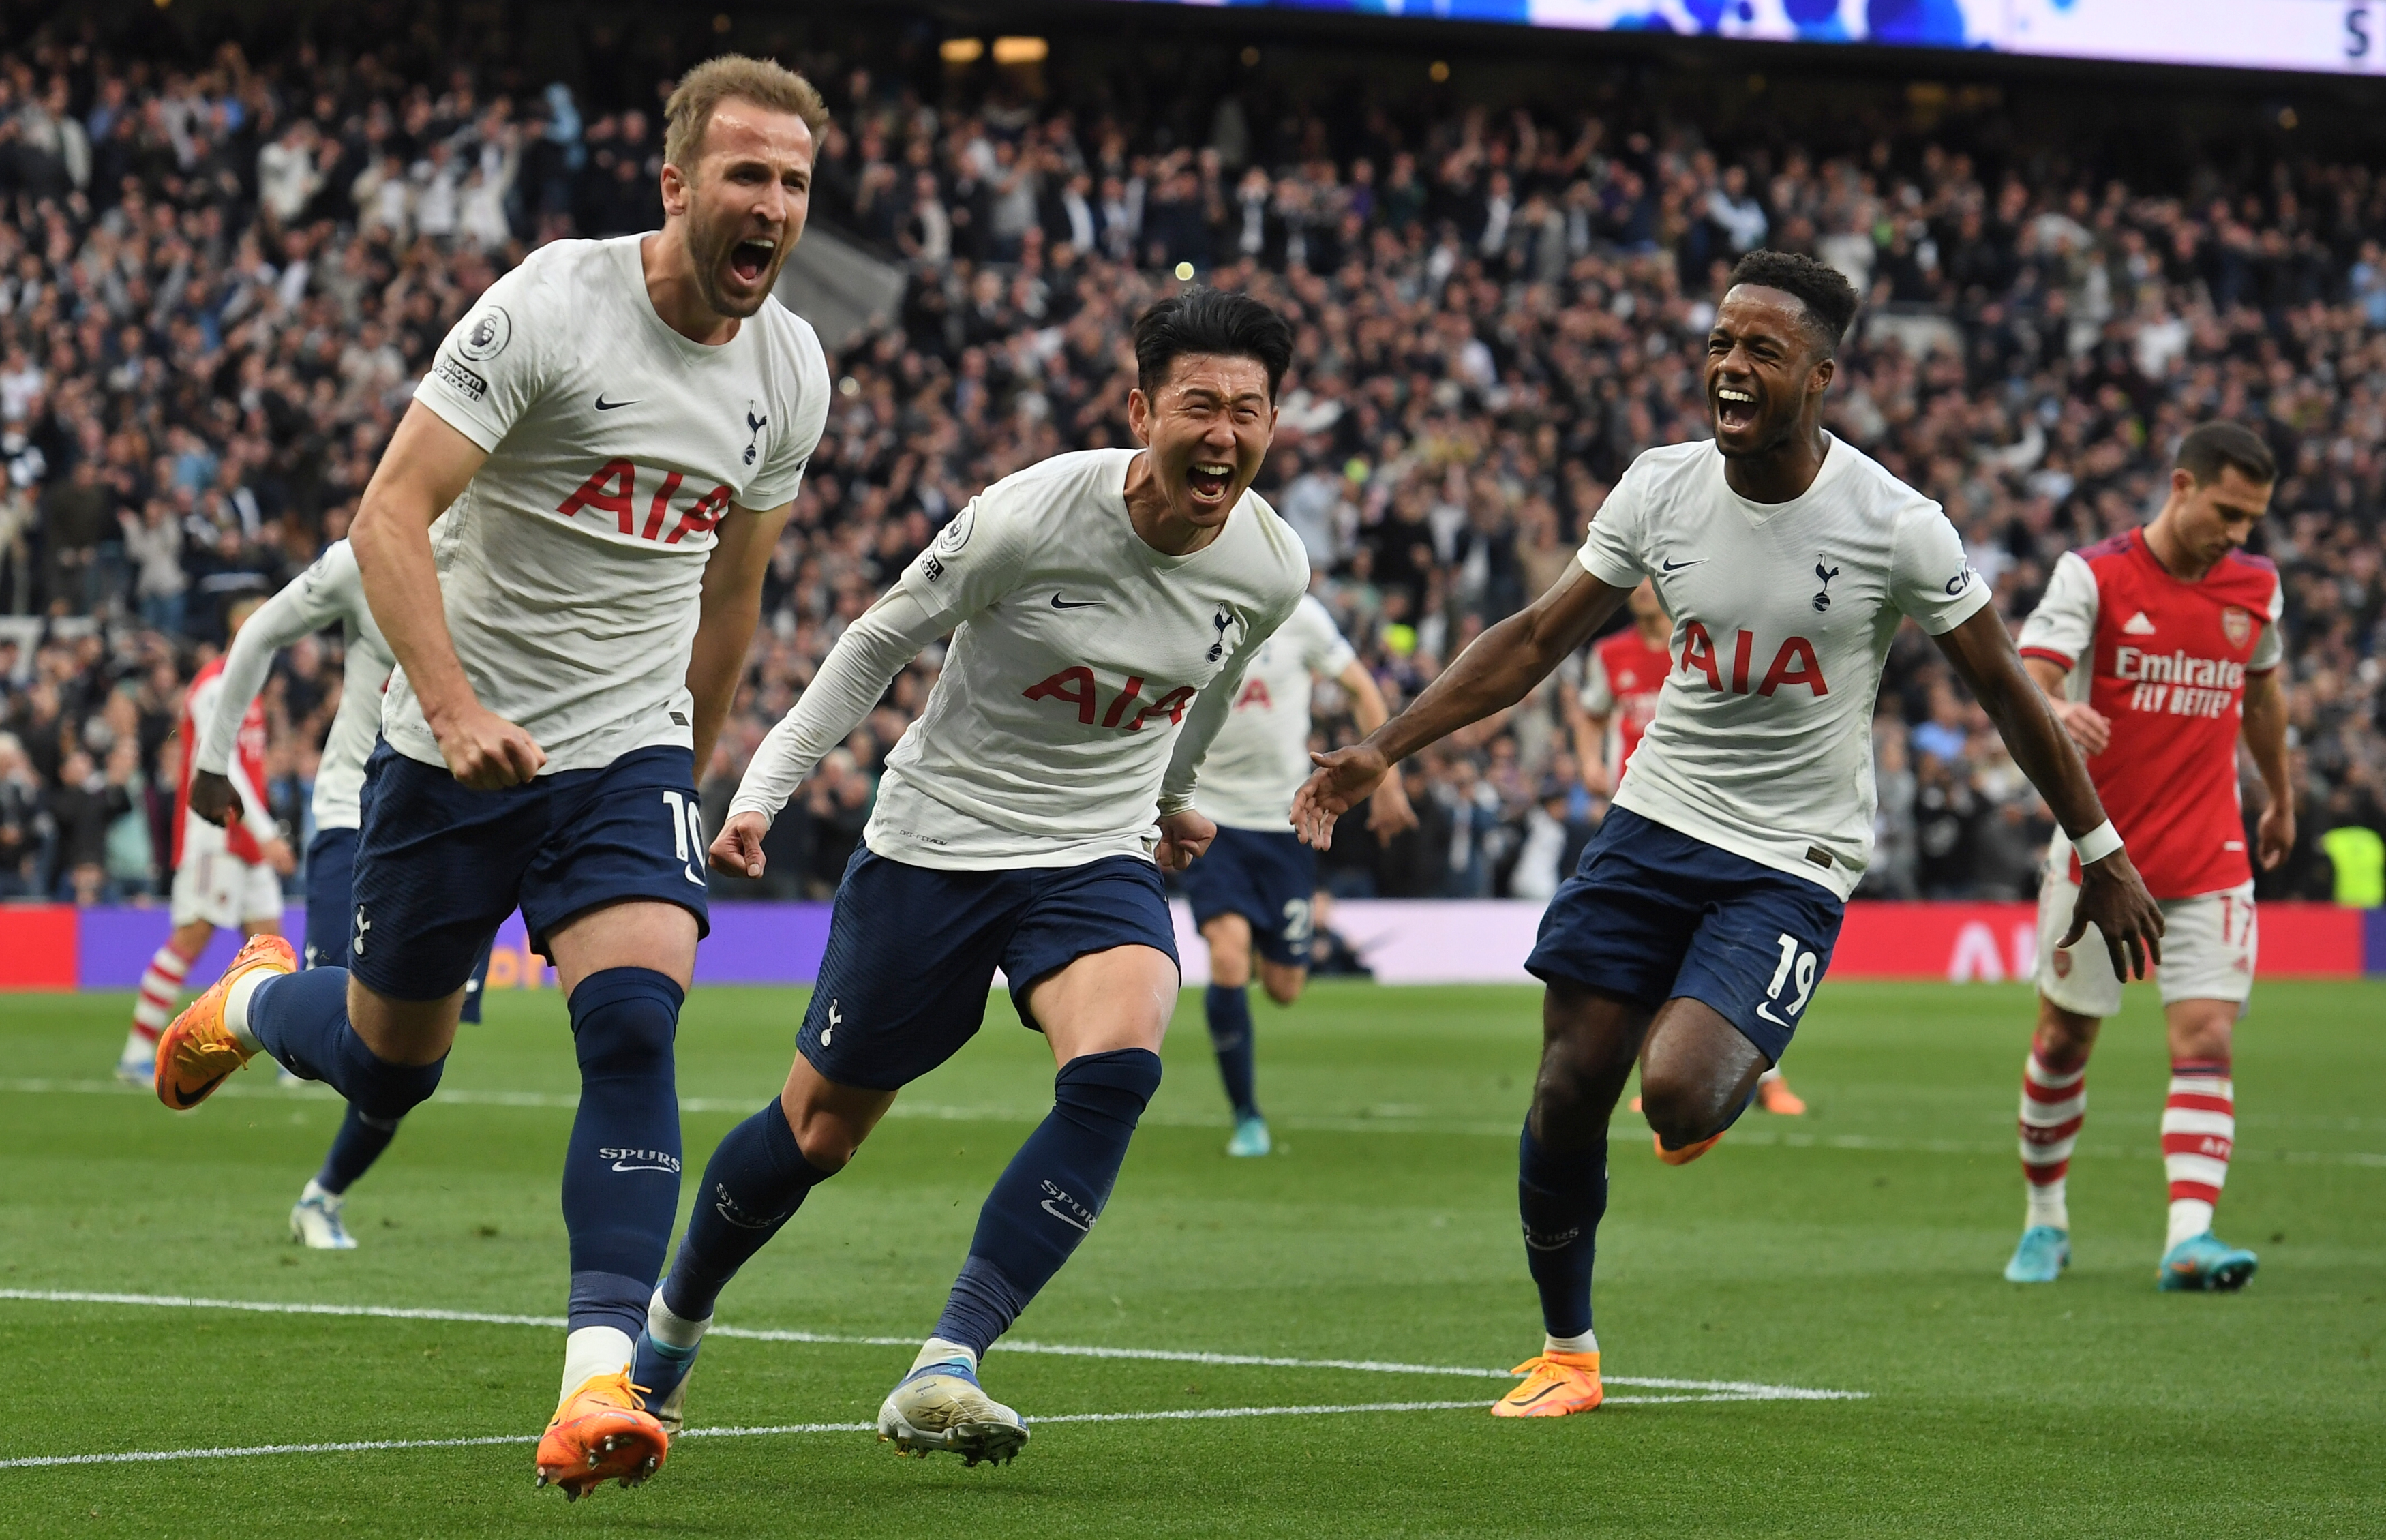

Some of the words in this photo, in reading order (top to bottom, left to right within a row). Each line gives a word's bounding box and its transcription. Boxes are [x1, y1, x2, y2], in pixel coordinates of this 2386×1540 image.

[452, 364, 482, 389] room
[555, 457, 733, 544] AIA
[1680, 620, 1829, 697] AIA
[1021, 665, 1196, 731] AIA
[2220, 895, 2254, 947] 17
[1766, 933, 1817, 1016] 19
[599, 1147, 680, 1173] SPURS
[1040, 1179, 1097, 1230] SPUR
